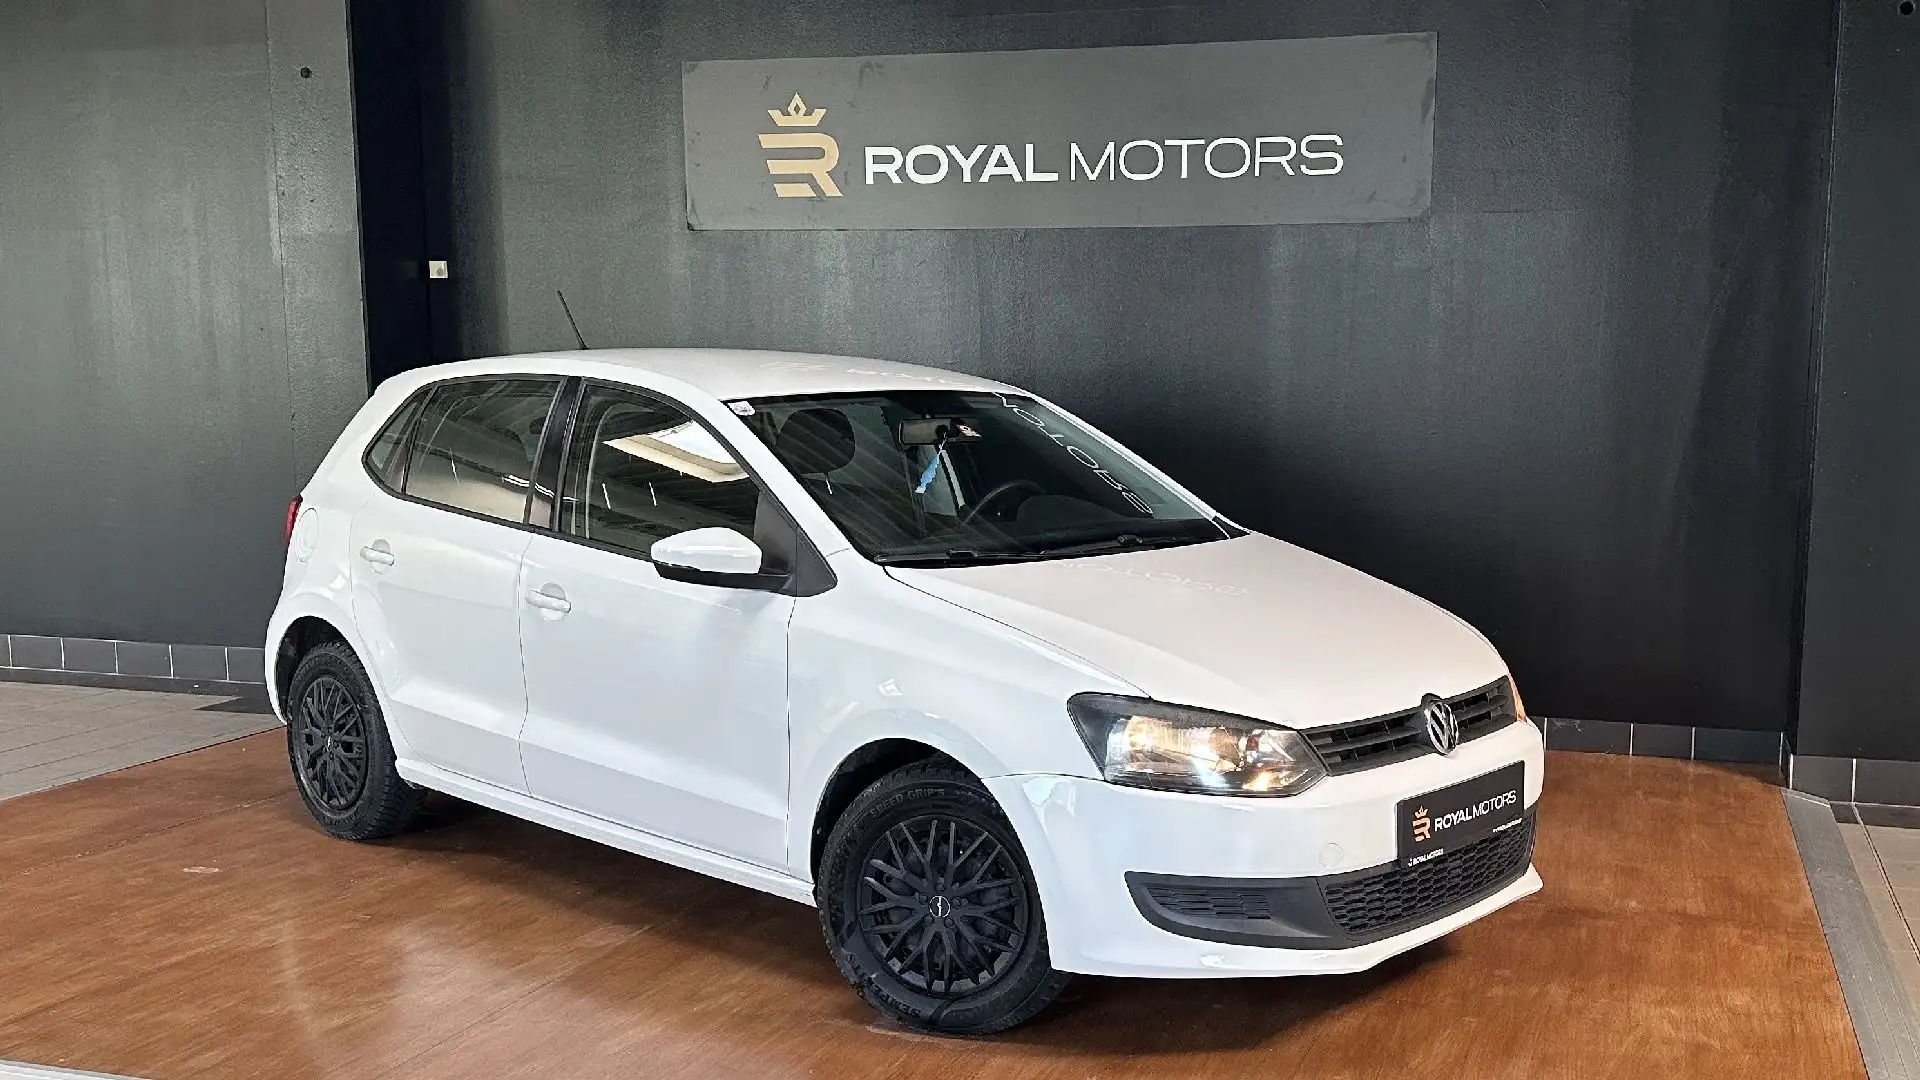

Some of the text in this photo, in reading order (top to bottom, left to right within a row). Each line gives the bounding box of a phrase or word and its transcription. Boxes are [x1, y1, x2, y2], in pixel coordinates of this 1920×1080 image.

[864, 134, 1344, 185] ROYAL MOTORS
[1434, 807, 1472, 832] ROYAL
[1472, 789, 1517, 819] MOTORS
